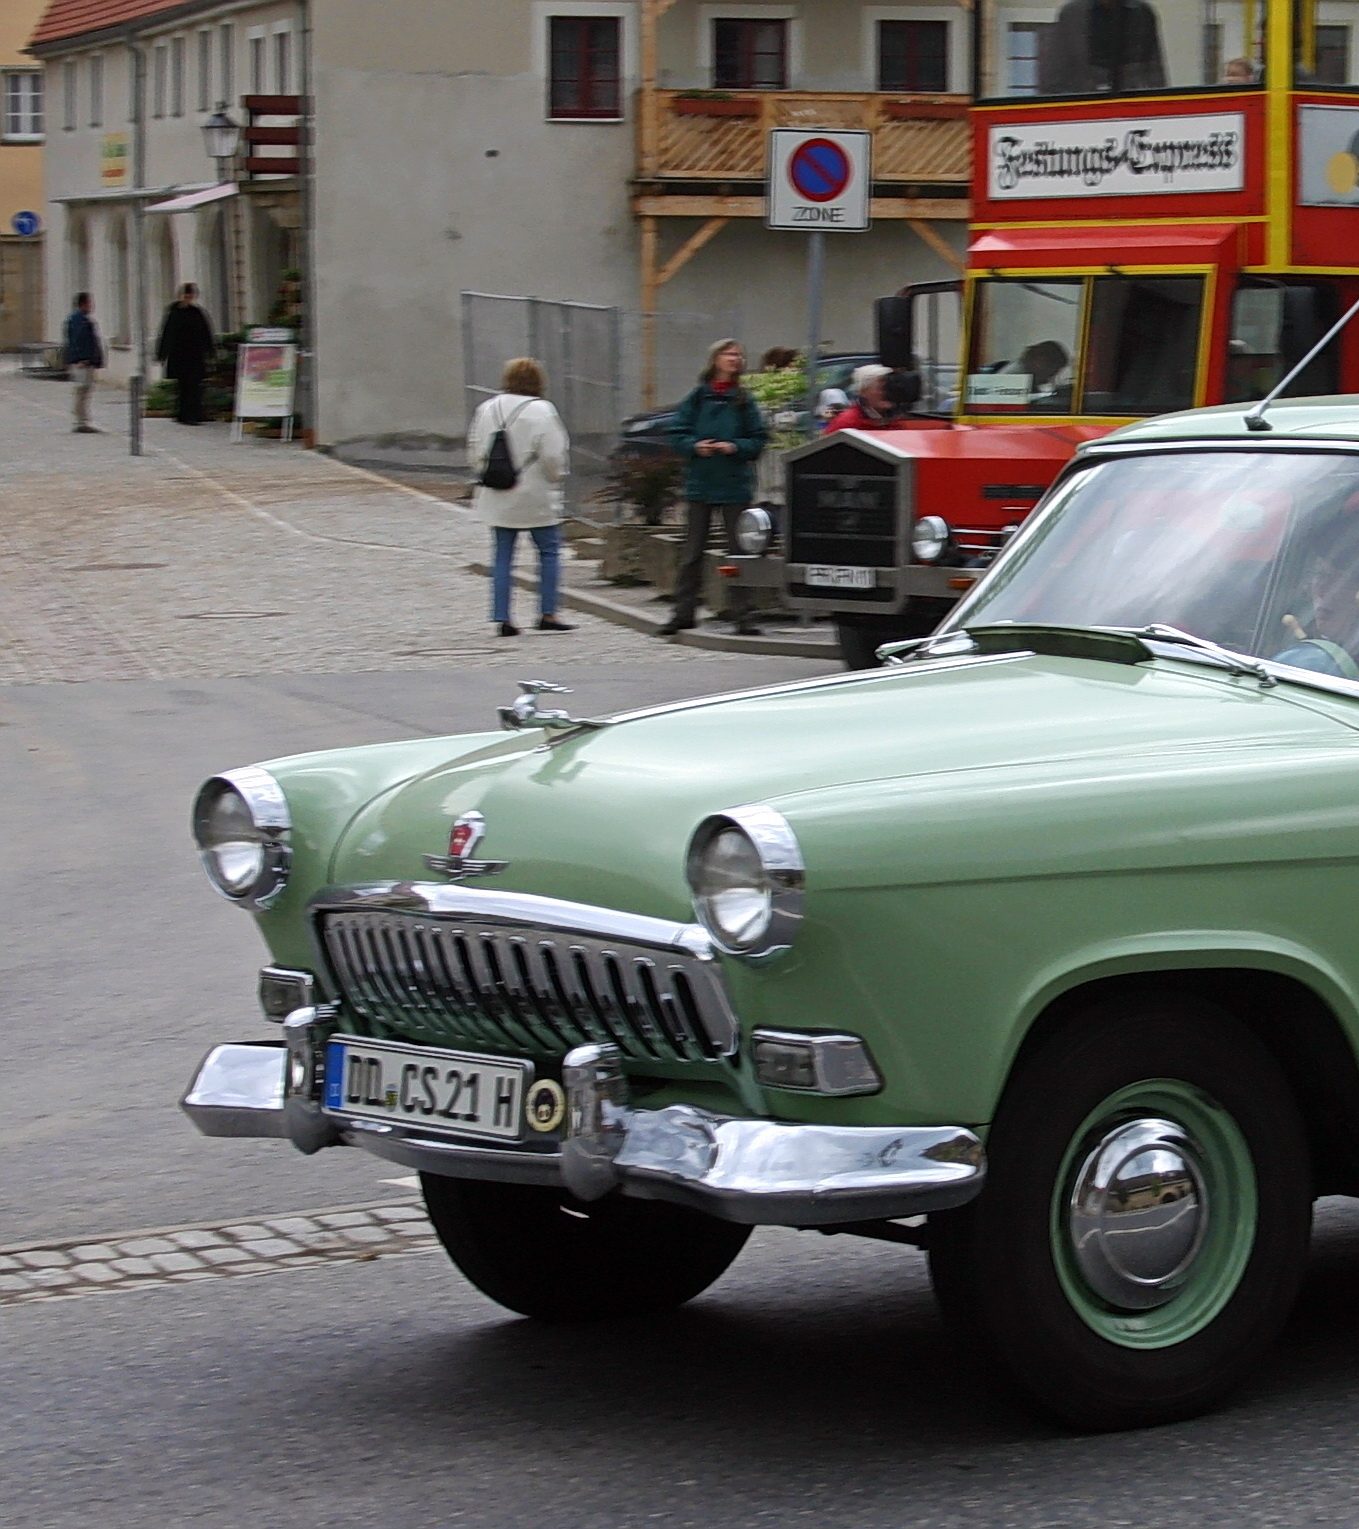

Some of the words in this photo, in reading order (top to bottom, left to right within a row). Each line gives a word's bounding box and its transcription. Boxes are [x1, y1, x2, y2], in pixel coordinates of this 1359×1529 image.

[791, 206, 846, 223] ZONE
[347, 1055, 384, 1106] DD
[493, 1076, 516, 1128] H
